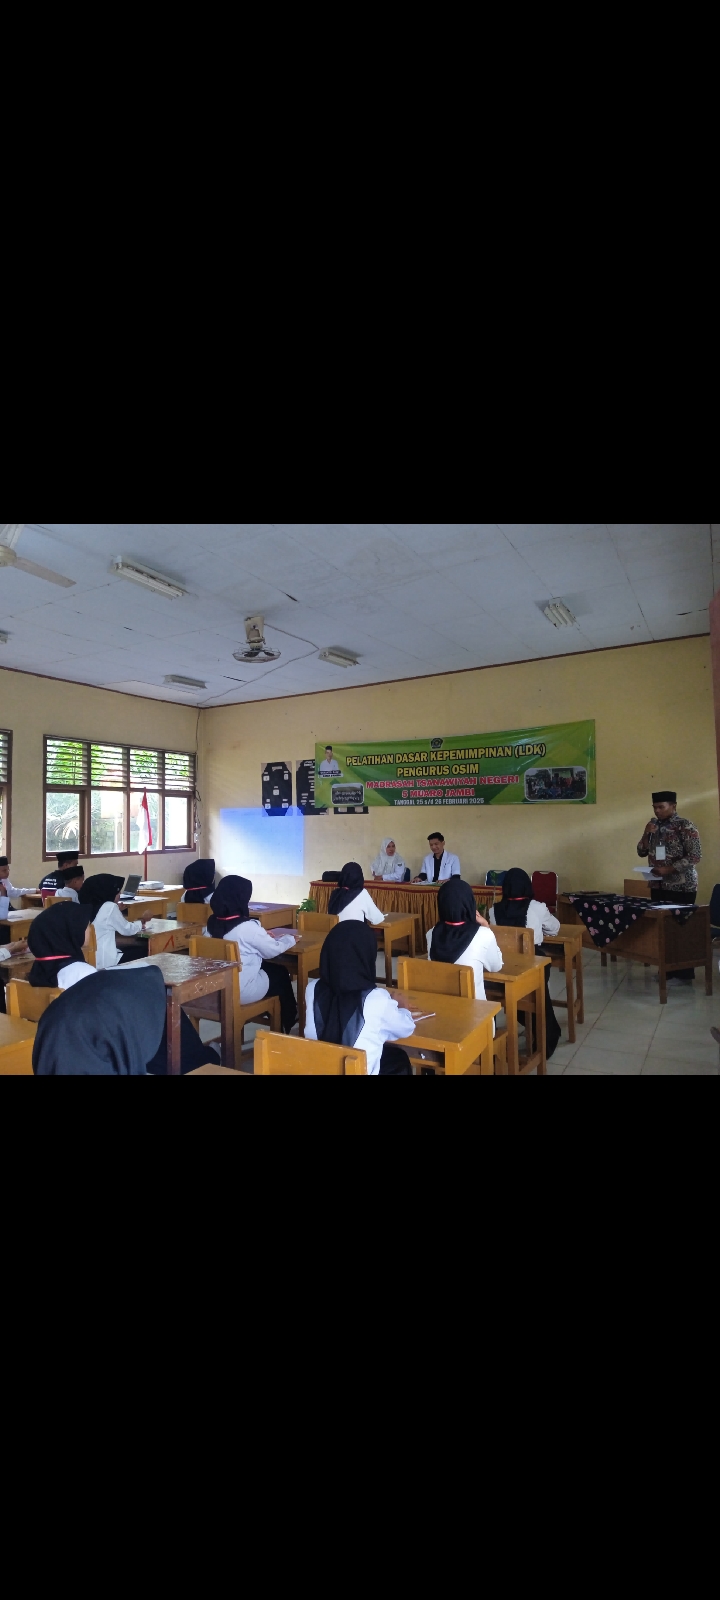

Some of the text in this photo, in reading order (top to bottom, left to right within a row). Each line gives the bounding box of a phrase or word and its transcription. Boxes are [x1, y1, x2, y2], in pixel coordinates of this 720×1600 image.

[346, 743, 546, 766] PELATIHAN DASAR KEPEMIMPINAN (LDK)
[397, 763, 479, 777] PENGURUS OSIM
[366, 775, 519, 789] MADRASAH TSANAWIYAH NEGERI
[402, 788, 475, 798] 5 MUARO JAMBI
